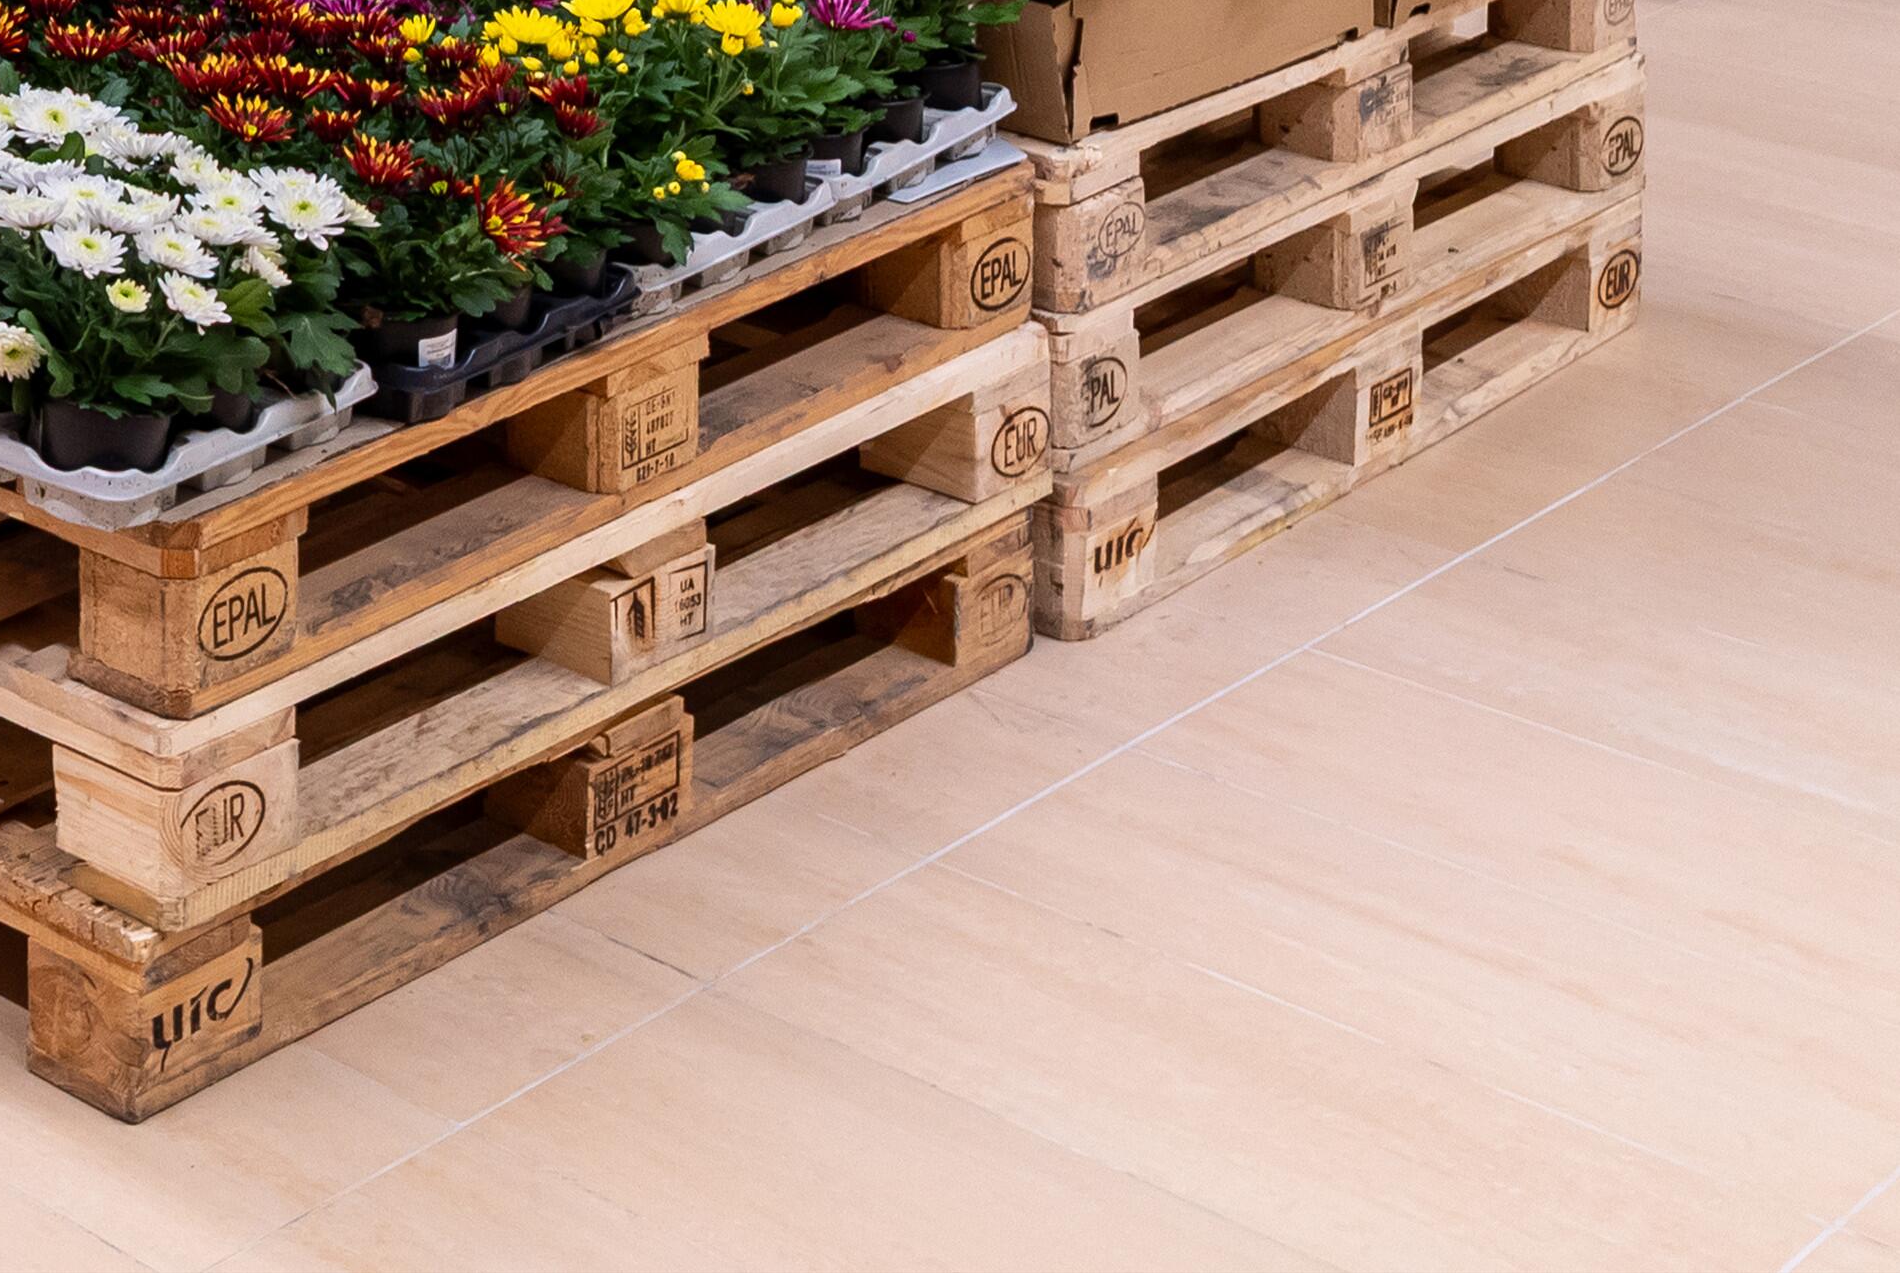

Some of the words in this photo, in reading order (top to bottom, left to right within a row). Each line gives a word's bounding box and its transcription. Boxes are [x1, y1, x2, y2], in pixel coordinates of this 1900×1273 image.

[1607, 125, 1641, 167] EPAL
[980, 250, 1022, 301] EPAL
[1605, 258, 1635, 298] EUR
[1003, 417, 1038, 469] EUR
[679, 577, 695, 593] UA
[211, 580, 277, 650] EPAL
[680, 612, 694, 627] HT
[595, 825, 617, 856] CD
